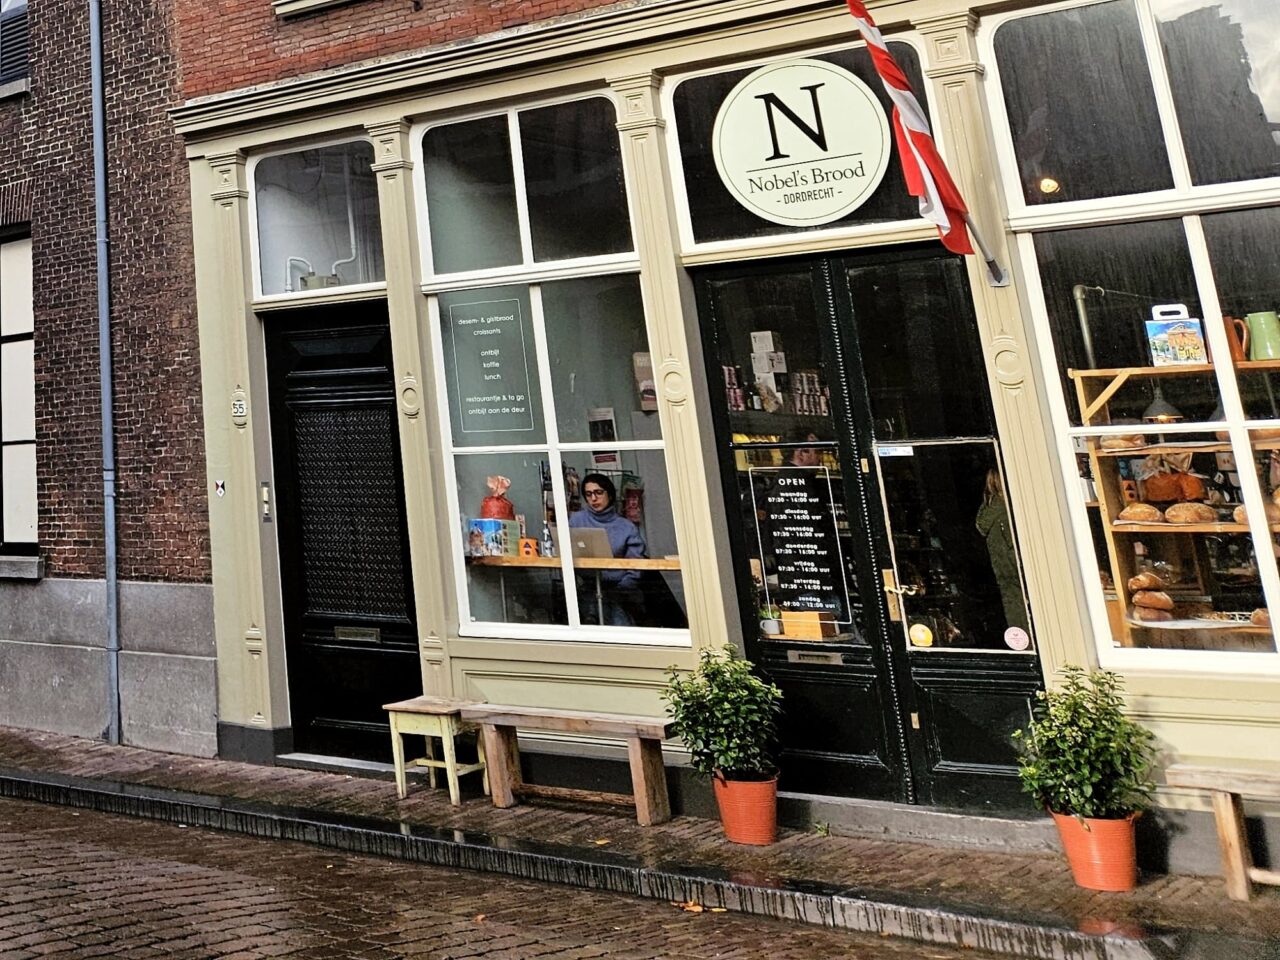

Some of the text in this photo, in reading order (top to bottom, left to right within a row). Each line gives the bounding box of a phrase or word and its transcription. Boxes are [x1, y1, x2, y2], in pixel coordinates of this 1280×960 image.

[754, 83, 828, 162] N
[748, 161, 866, 194] Nobel's Brood
[783, 187, 835, 205] DORDRECHT
[473, 328, 501, 336] croissants
[480, 349, 500, 357] ontbijt
[232, 402, 245, 414] 55
[778, 478, 806, 486] OPEN
